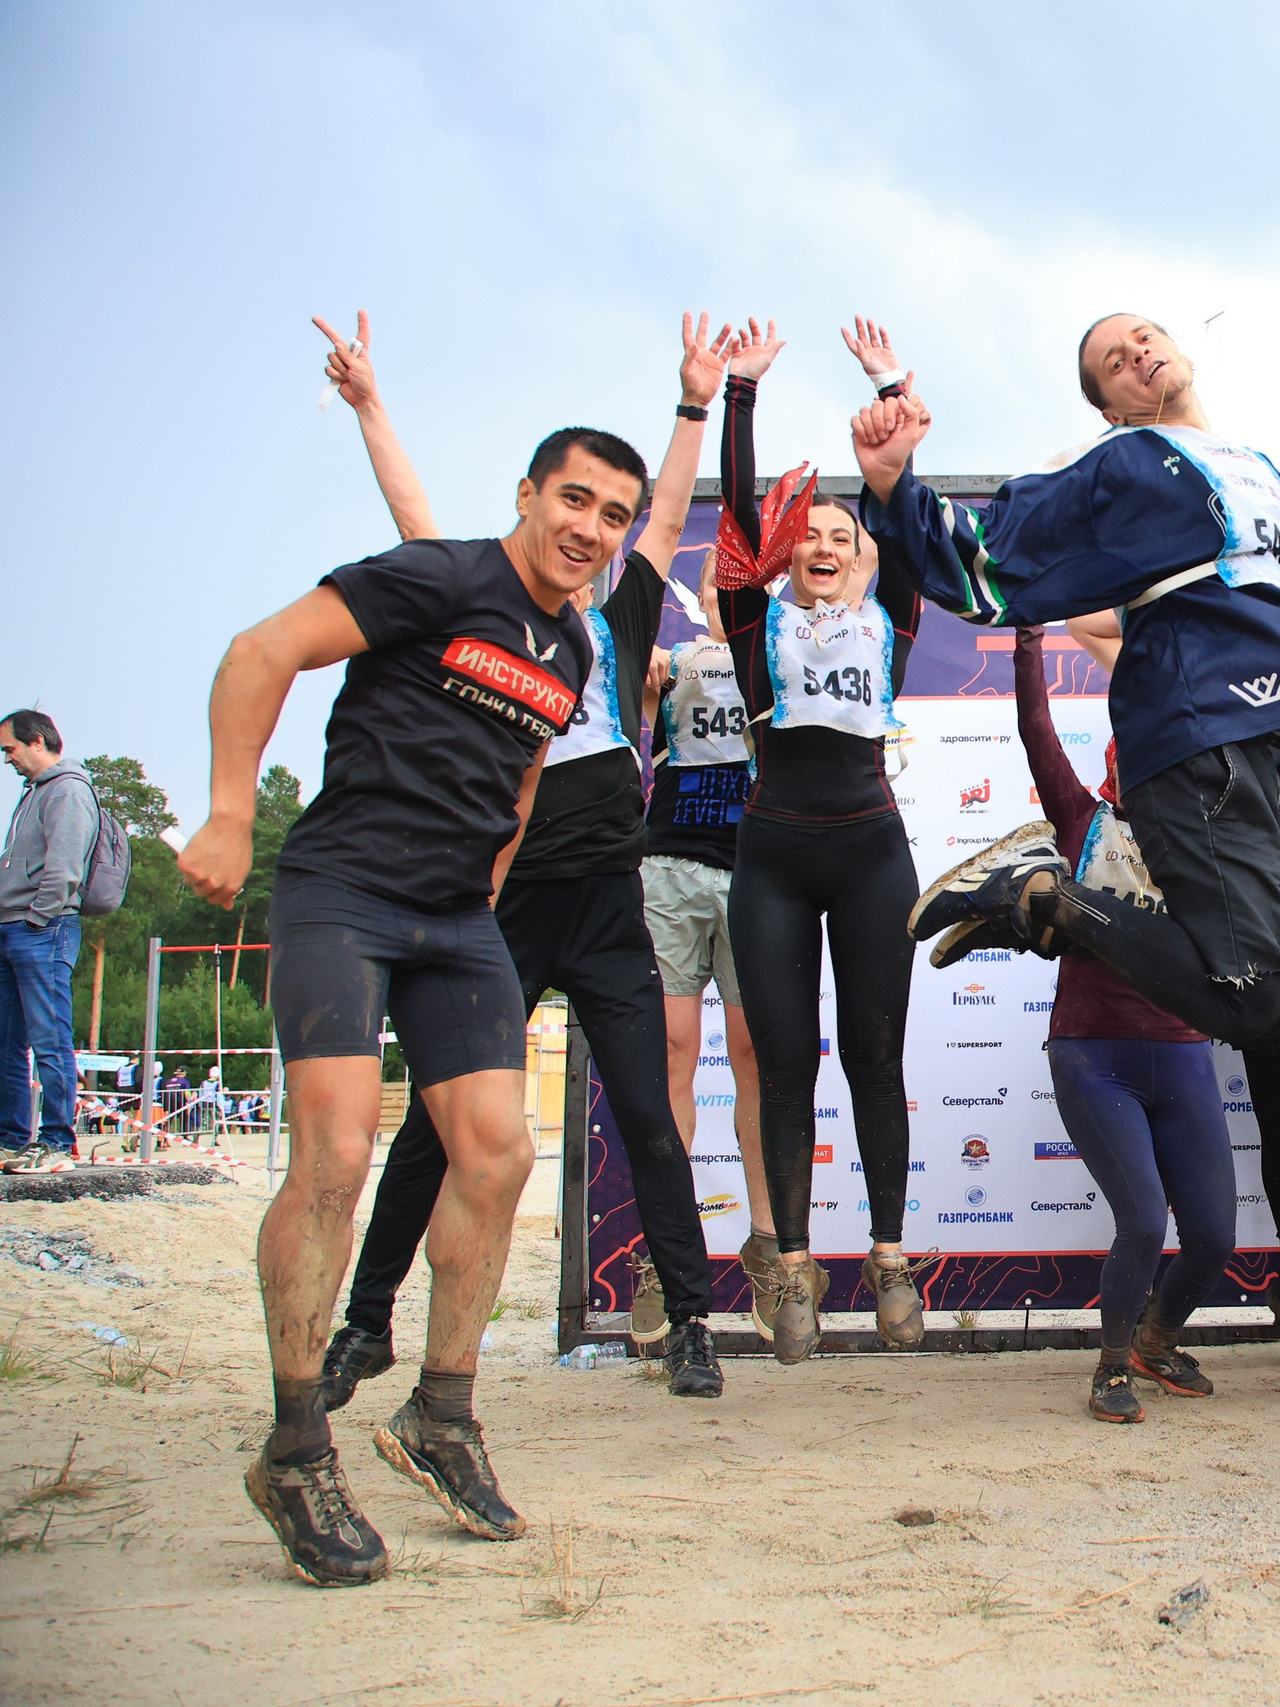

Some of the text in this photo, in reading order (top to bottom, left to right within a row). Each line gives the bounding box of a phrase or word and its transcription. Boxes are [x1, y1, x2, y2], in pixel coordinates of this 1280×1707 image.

[455, 644, 575, 722] ИНСТРУКТО
[803, 664, 871, 707] 5436
[520, 712, 556, 743] ГЕРО
[692, 706, 747, 739] 543
[942, 1096, 1004, 1108] Северсталь
[1045, 1143, 1077, 1151] РОССИ
[689, 1154, 742, 1165] еверсталь
[1031, 1201, 1092, 1213] Северсталь
[938, 1212, 1014, 1223] ГАЗПРОМБАНК
